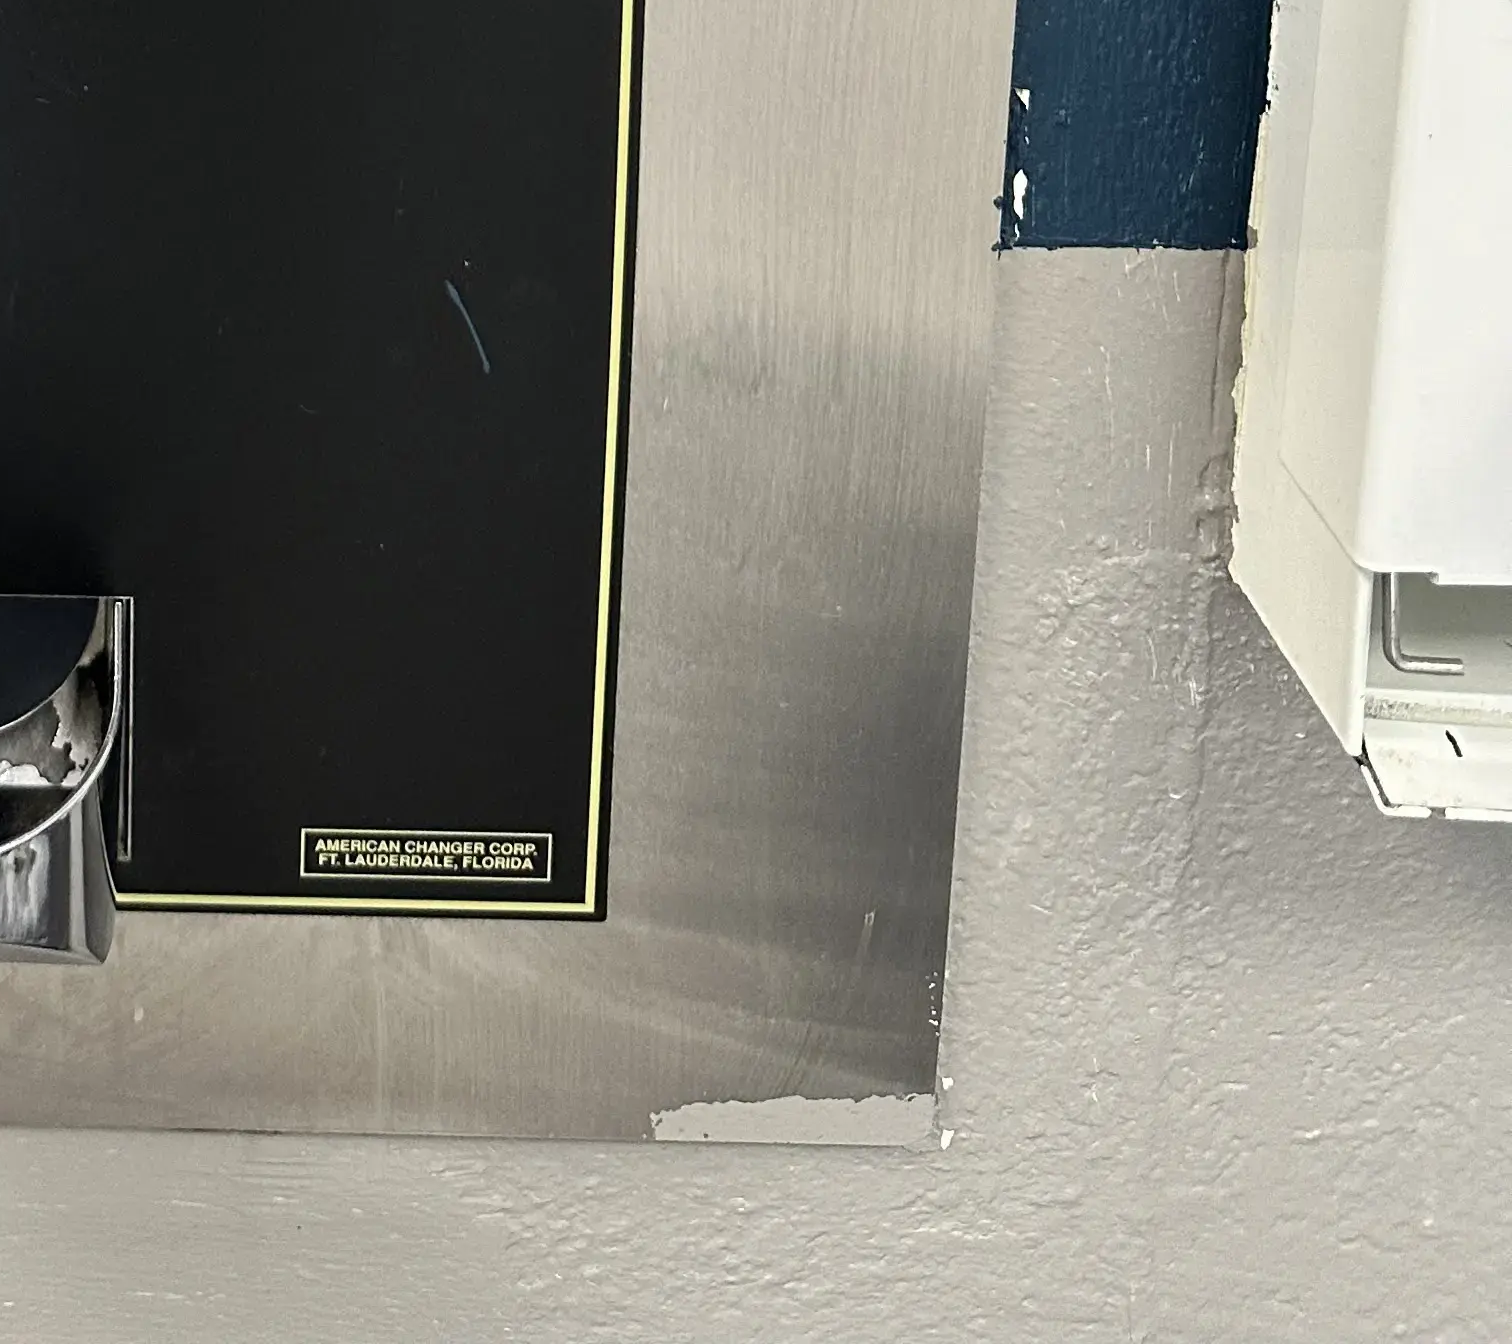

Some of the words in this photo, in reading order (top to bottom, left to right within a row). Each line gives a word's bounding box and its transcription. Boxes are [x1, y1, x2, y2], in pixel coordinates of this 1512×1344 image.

[314, 838, 401, 853] AMERICAN
[404, 840, 486, 855] CHANGER
[488, 842, 538, 856] CORP.
[318, 853, 341, 866] FT.
[344, 853, 459, 871] LAUDERDALE,
[462, 857, 534, 870] FLORIDA
